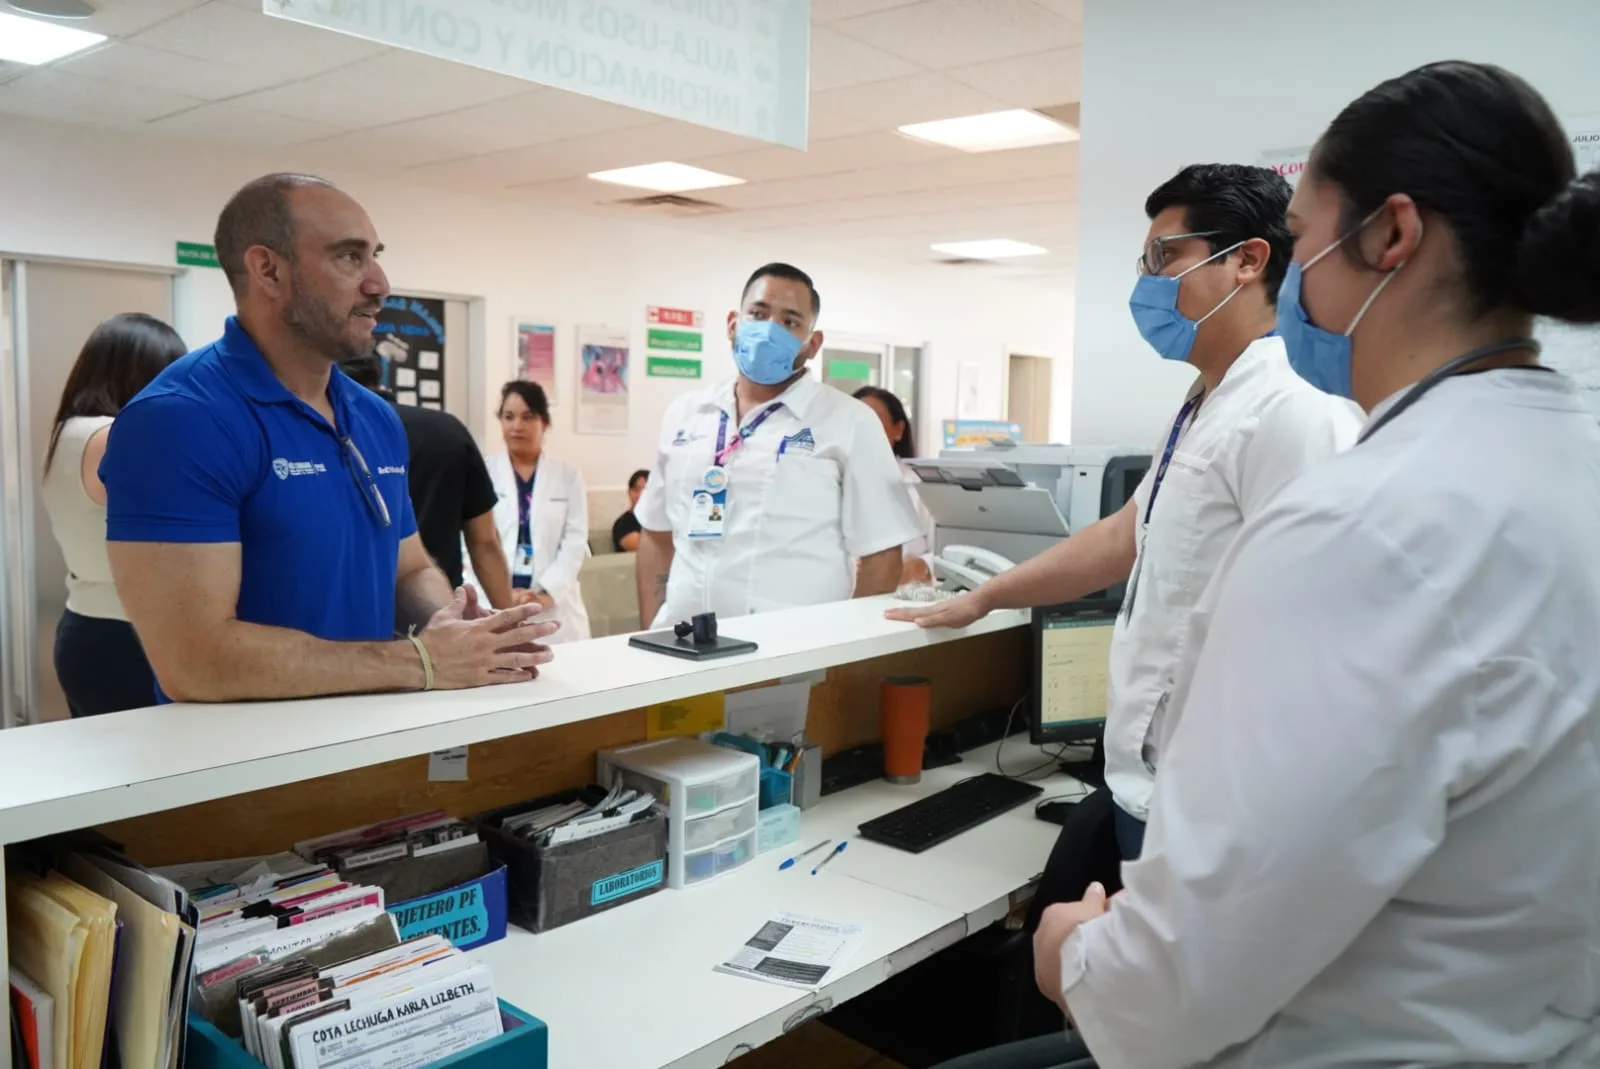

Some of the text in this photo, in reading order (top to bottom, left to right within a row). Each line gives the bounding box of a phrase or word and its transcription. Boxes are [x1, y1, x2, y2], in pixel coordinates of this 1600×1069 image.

[1572, 133, 1600, 143] JULIO
[599, 866, 657, 896] LABORATORIOS
[272, 986, 317, 1005] SEPTIEMBRE
[313, 982, 476, 1044] COTA LECHUGA KARLA LIZBETH
